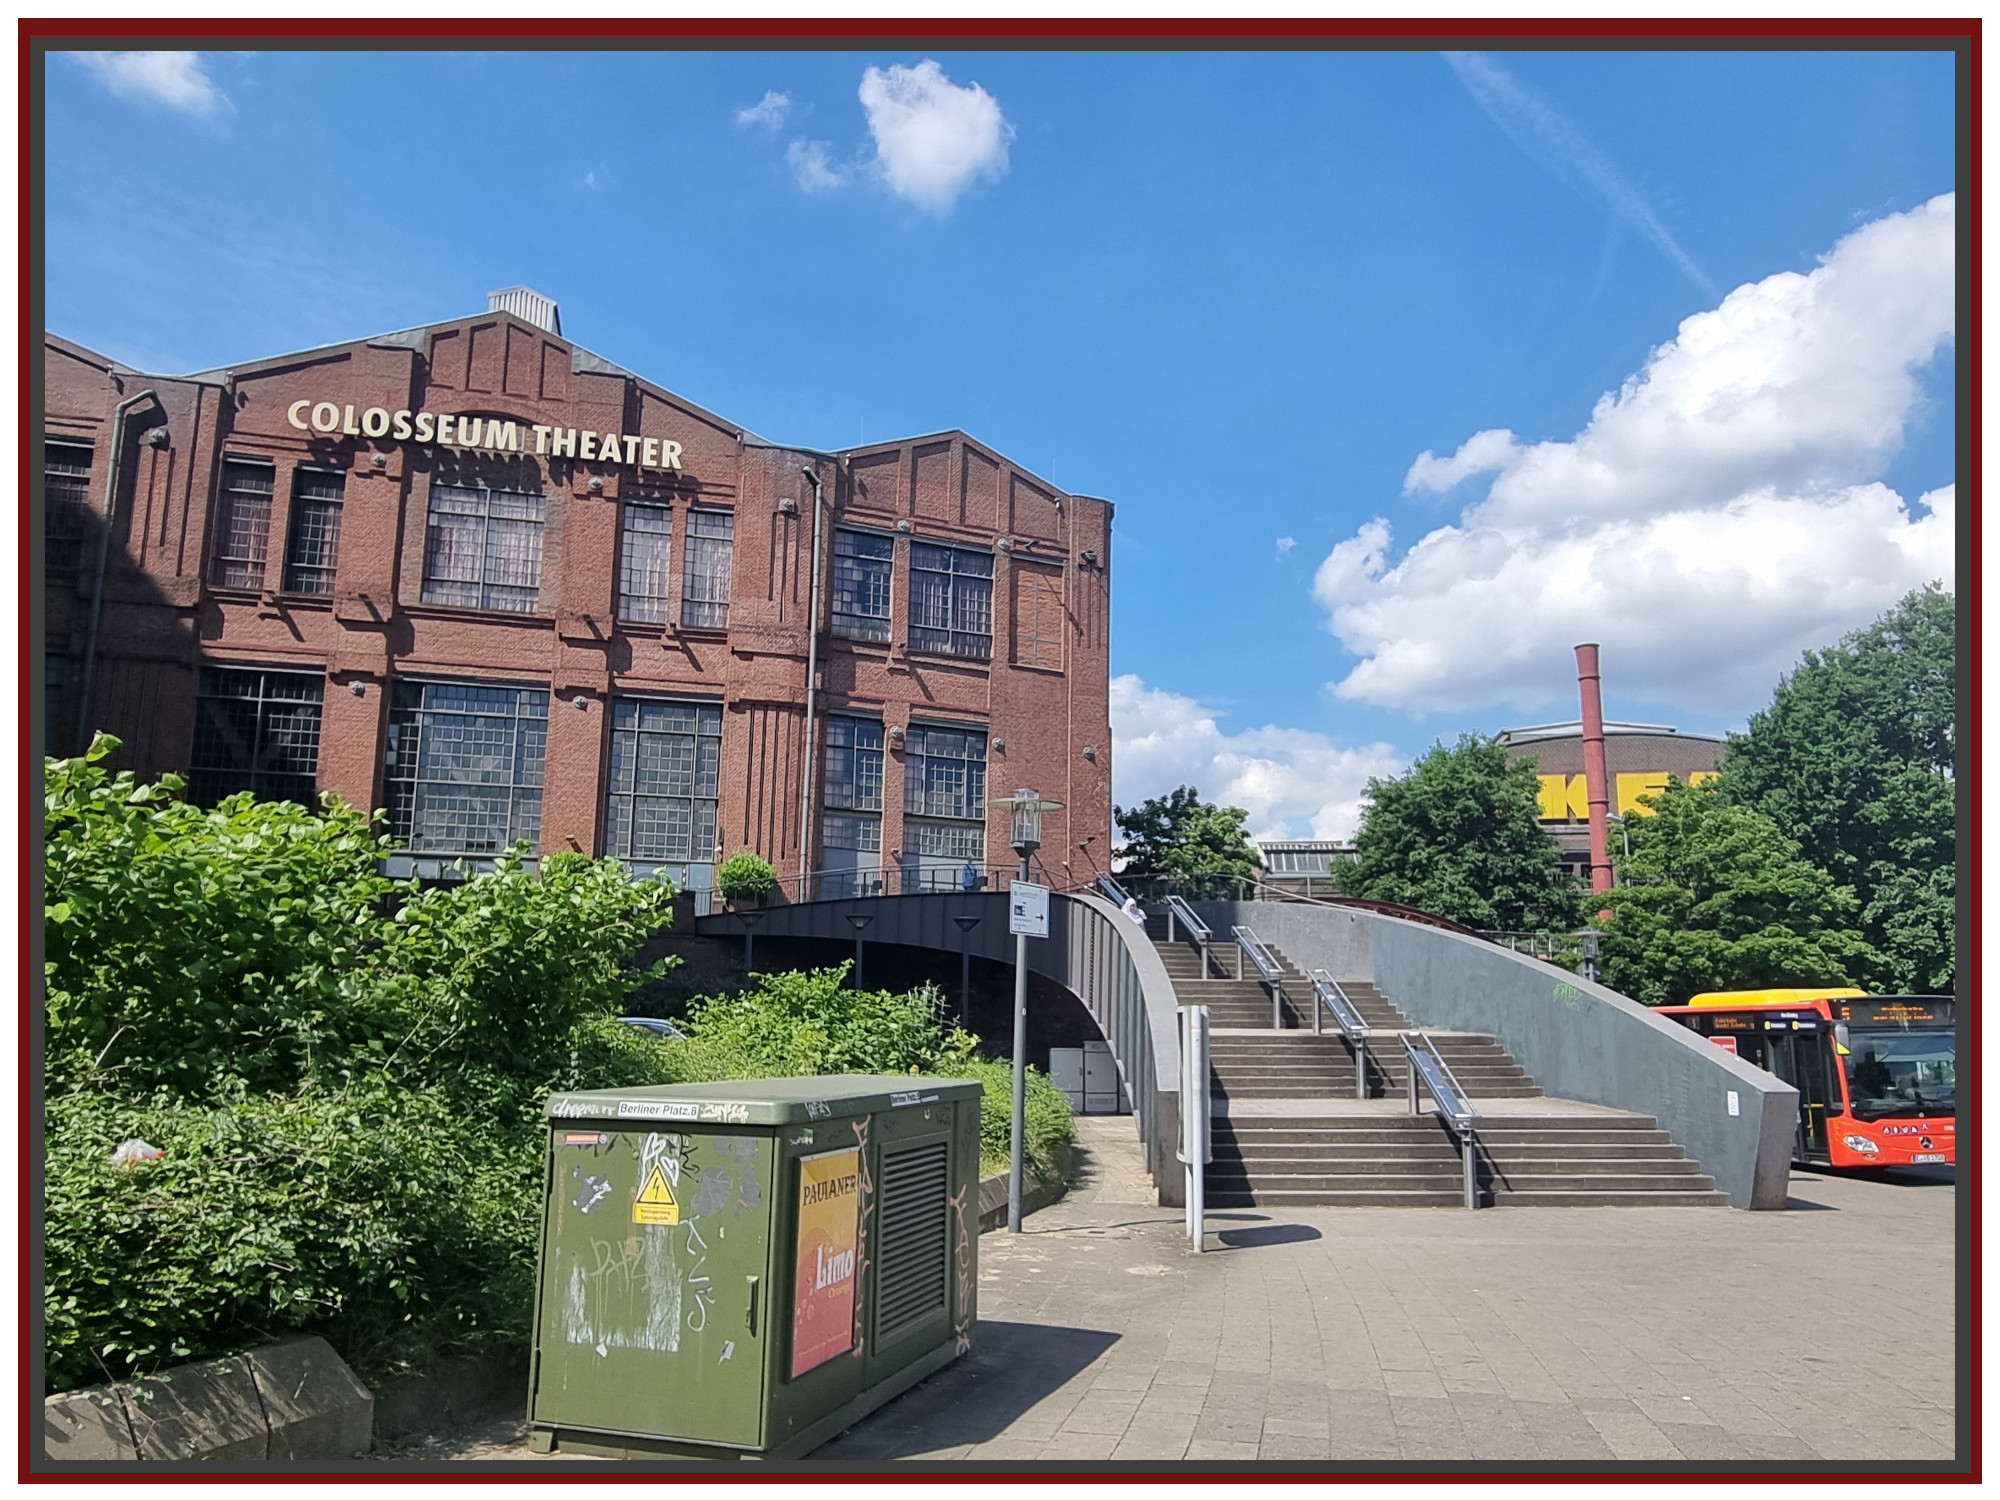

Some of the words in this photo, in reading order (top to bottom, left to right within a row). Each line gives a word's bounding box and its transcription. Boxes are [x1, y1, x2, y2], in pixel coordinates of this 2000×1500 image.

[287, 400, 518, 452] COLOSSEUM
[532, 424, 684, 470] THEATER
[620, 1103, 661, 1115] Berliner
[803, 1174, 857, 1207] PAULANER
[816, 1243, 854, 1291] Limo
